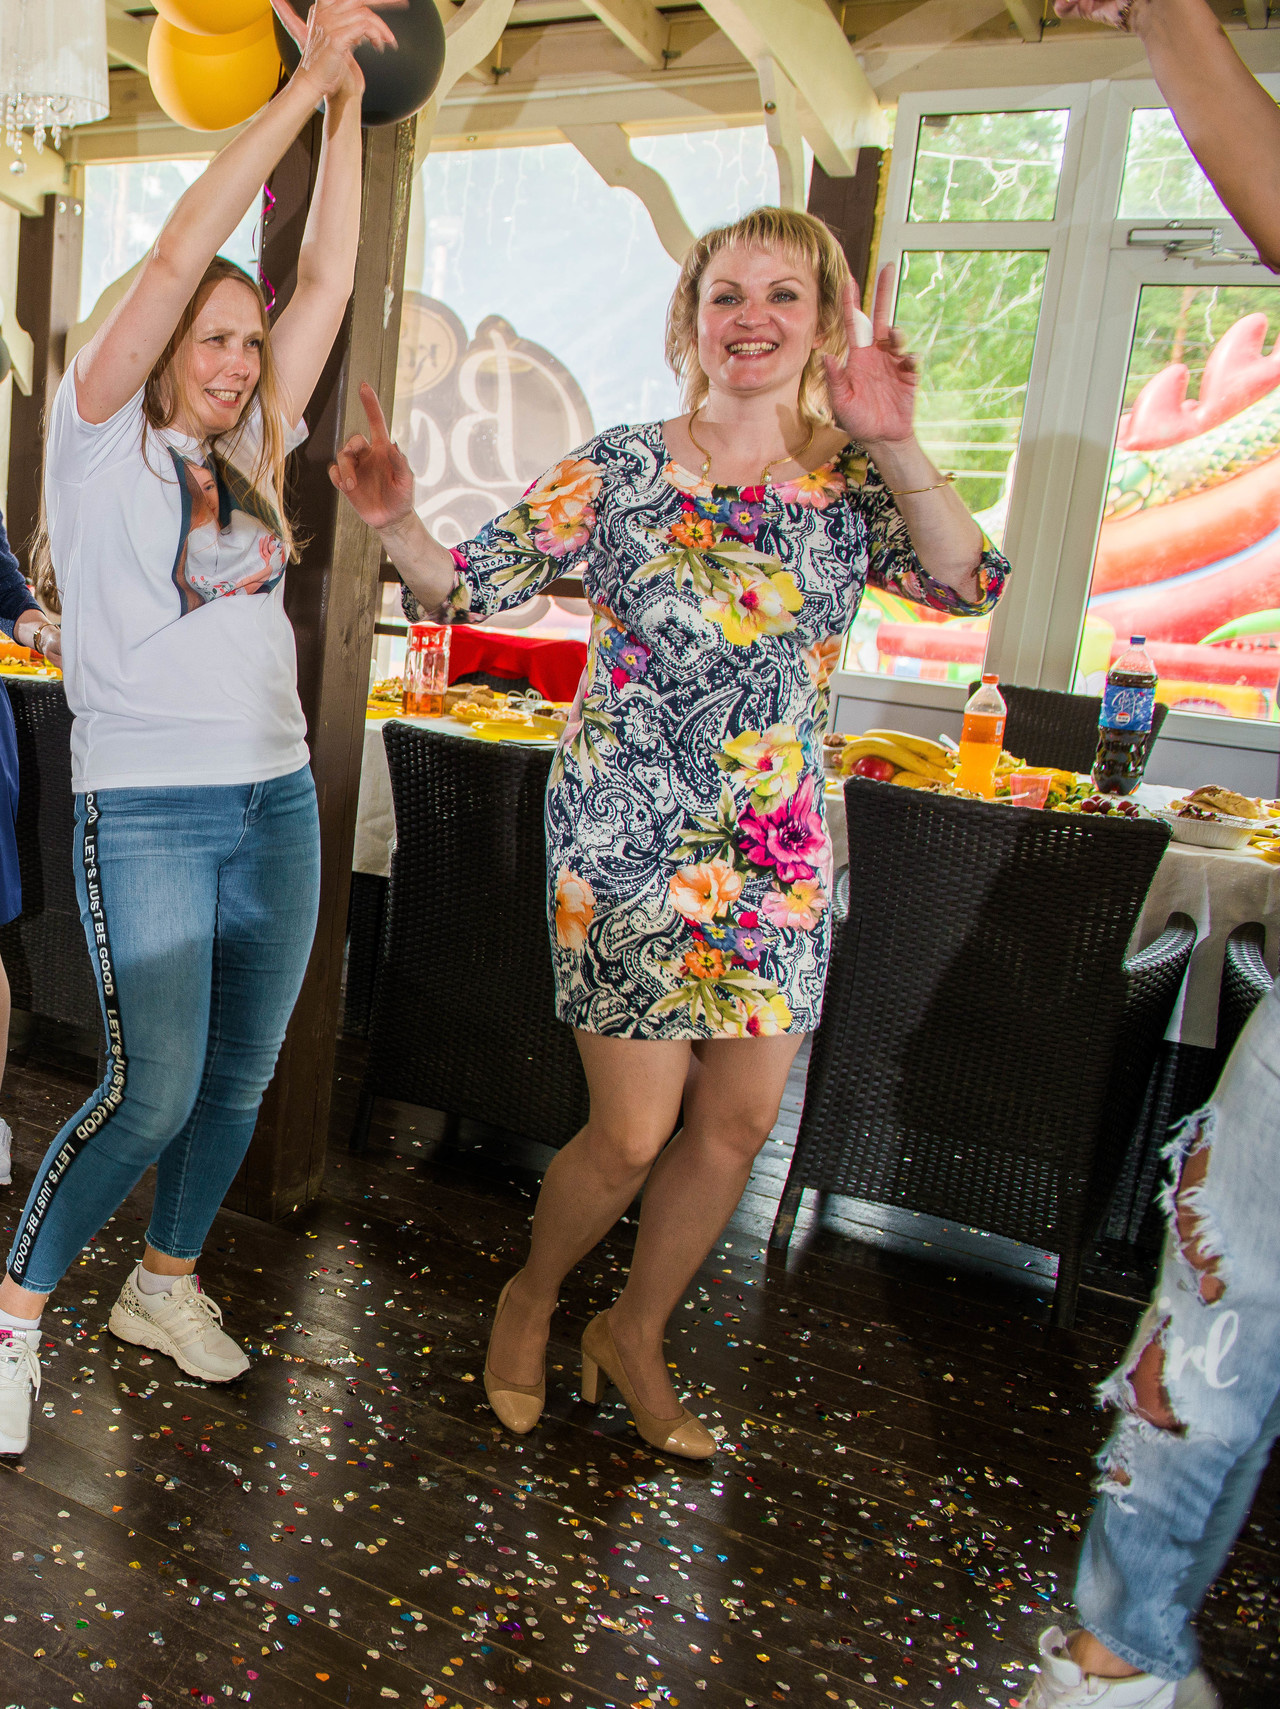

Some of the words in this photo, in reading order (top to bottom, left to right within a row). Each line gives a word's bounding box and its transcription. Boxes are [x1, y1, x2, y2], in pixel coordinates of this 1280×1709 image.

[86, 791, 98, 824] OOD
[84, 835, 98, 878] LET'S
[88, 882, 104, 922] JUST
[94, 922, 107, 944] BE
[99, 947, 115, 996] GOOD
[107, 1009, 123, 1056] LET'S
[109, 1055, 126, 1094] JUST
[103, 1091, 123, 1112] BE
[48, 1143, 76, 1184] LET'S
[34, 1180, 53, 1219] JUST
[25, 1213, 40, 1237] BE
[13, 1233, 31, 1274] GOOD
